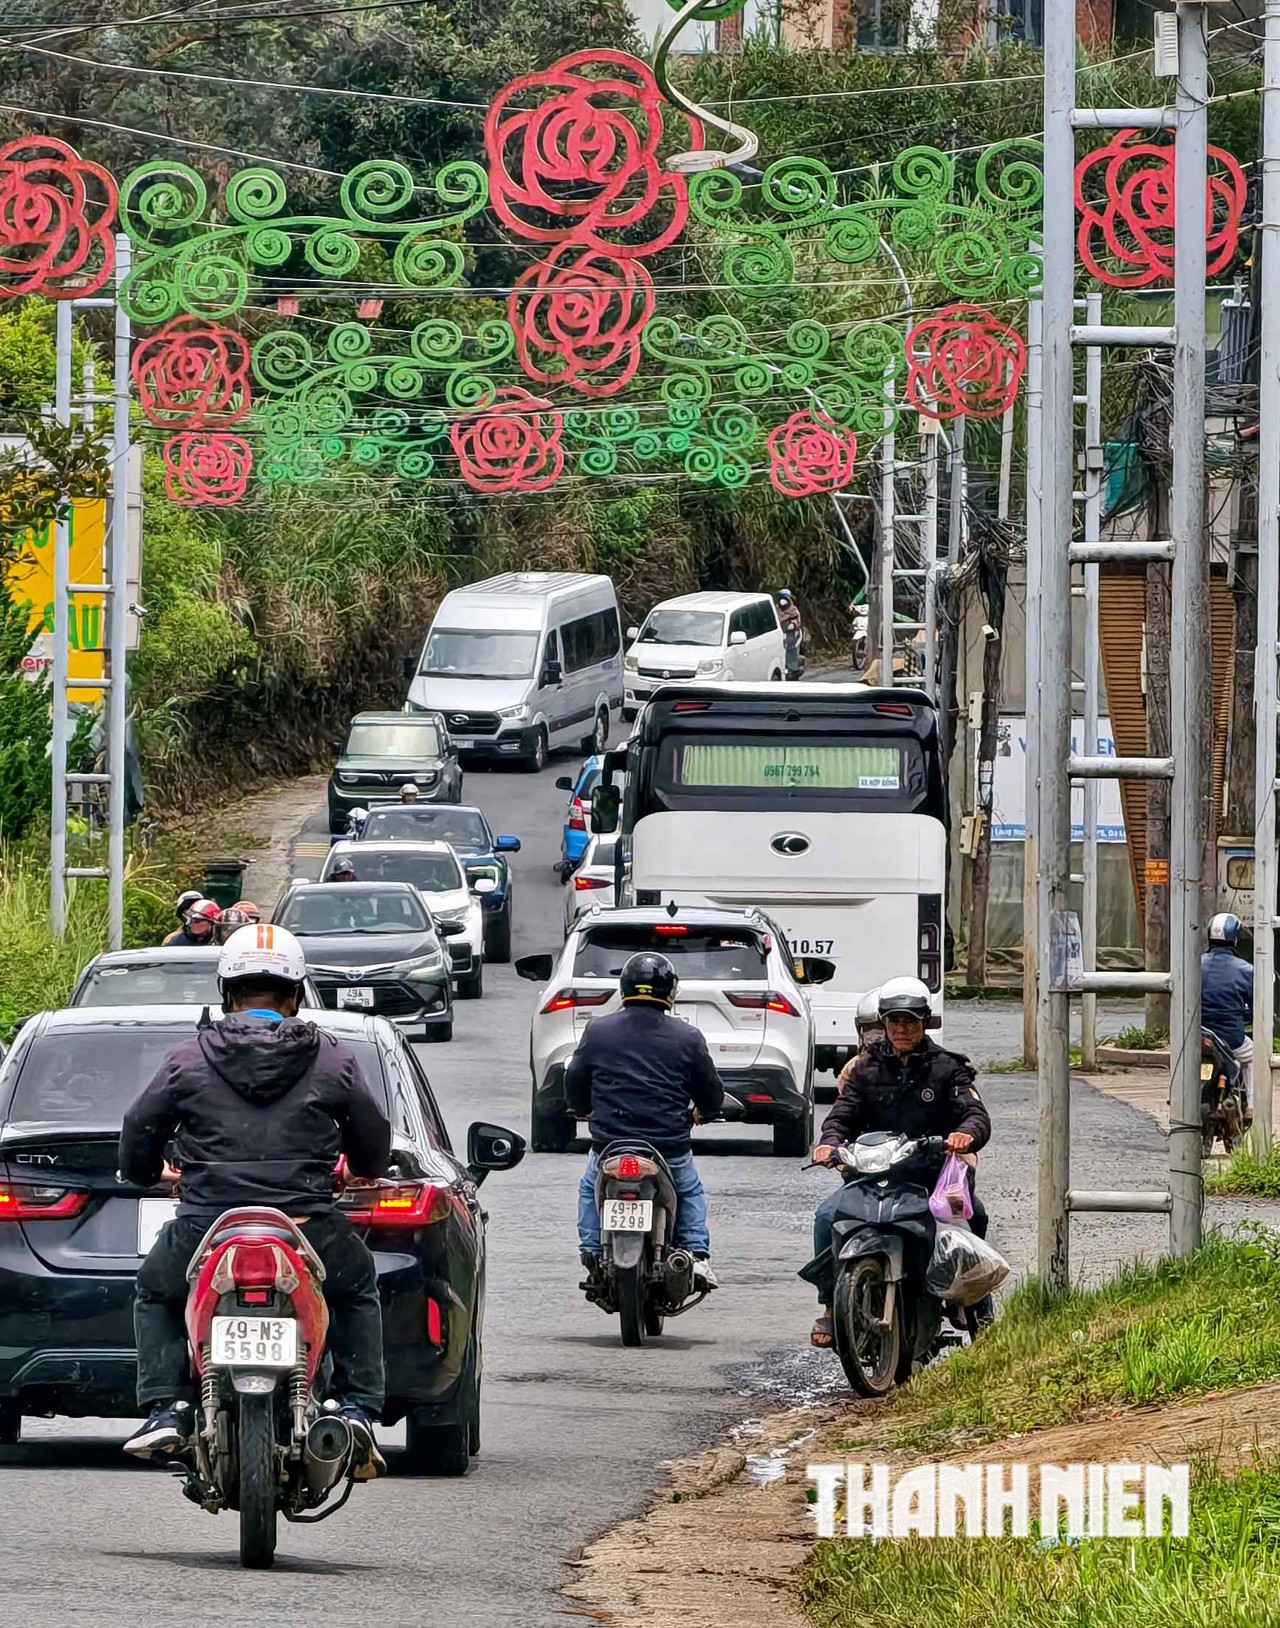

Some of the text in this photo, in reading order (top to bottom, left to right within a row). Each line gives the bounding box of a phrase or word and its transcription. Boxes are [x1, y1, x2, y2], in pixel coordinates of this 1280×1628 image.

[16, 1154, 59, 1164] CITY
[611, 1202, 645, 1215] 49-P1
[610, 1216, 644, 1229] 5298
[225, 1321, 283, 1341] 49-N3
[224, 1340, 282, 1361] 5598
